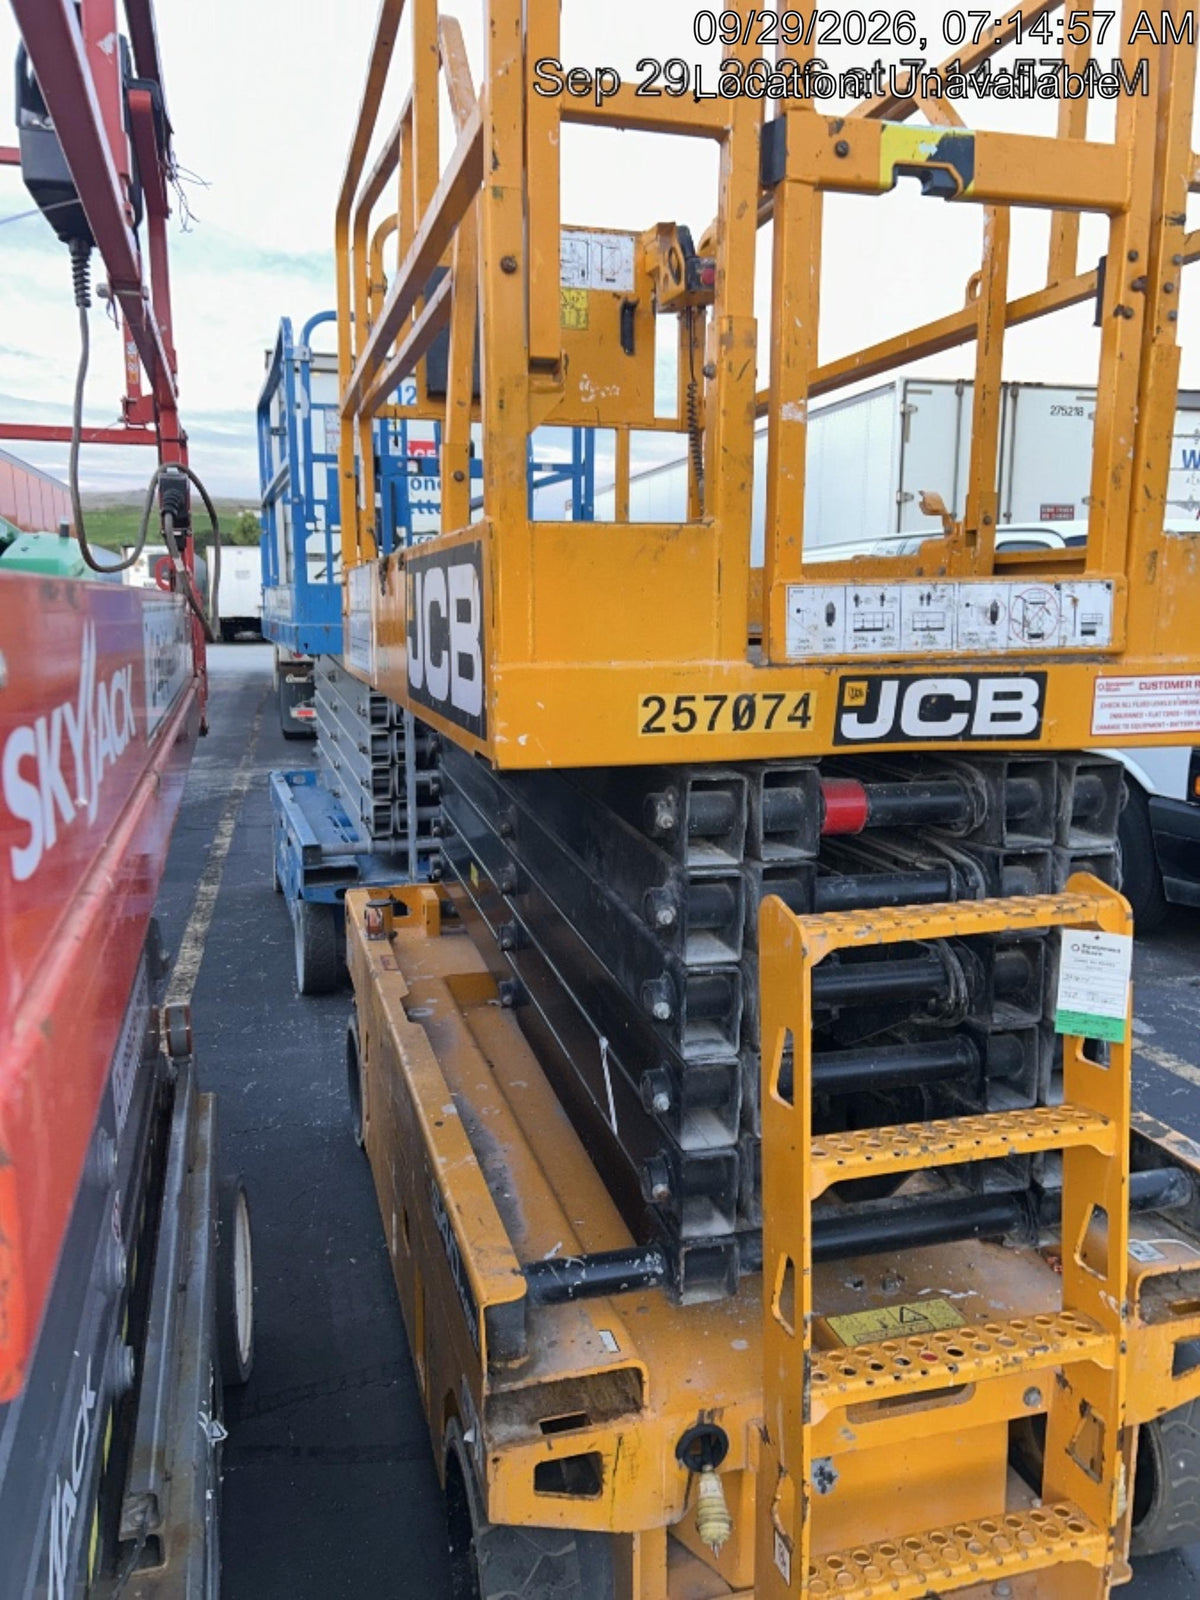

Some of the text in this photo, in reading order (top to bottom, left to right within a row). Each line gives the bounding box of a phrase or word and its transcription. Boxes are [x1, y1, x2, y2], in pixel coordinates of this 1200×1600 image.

[407, 563, 484, 717] JCB
[641, 692, 812, 735] 257074
[840, 677, 1040, 740] JCB
[1138, 680, 1192, 691] CUSTOMER
[3, 618, 137, 881] SKYJACK
